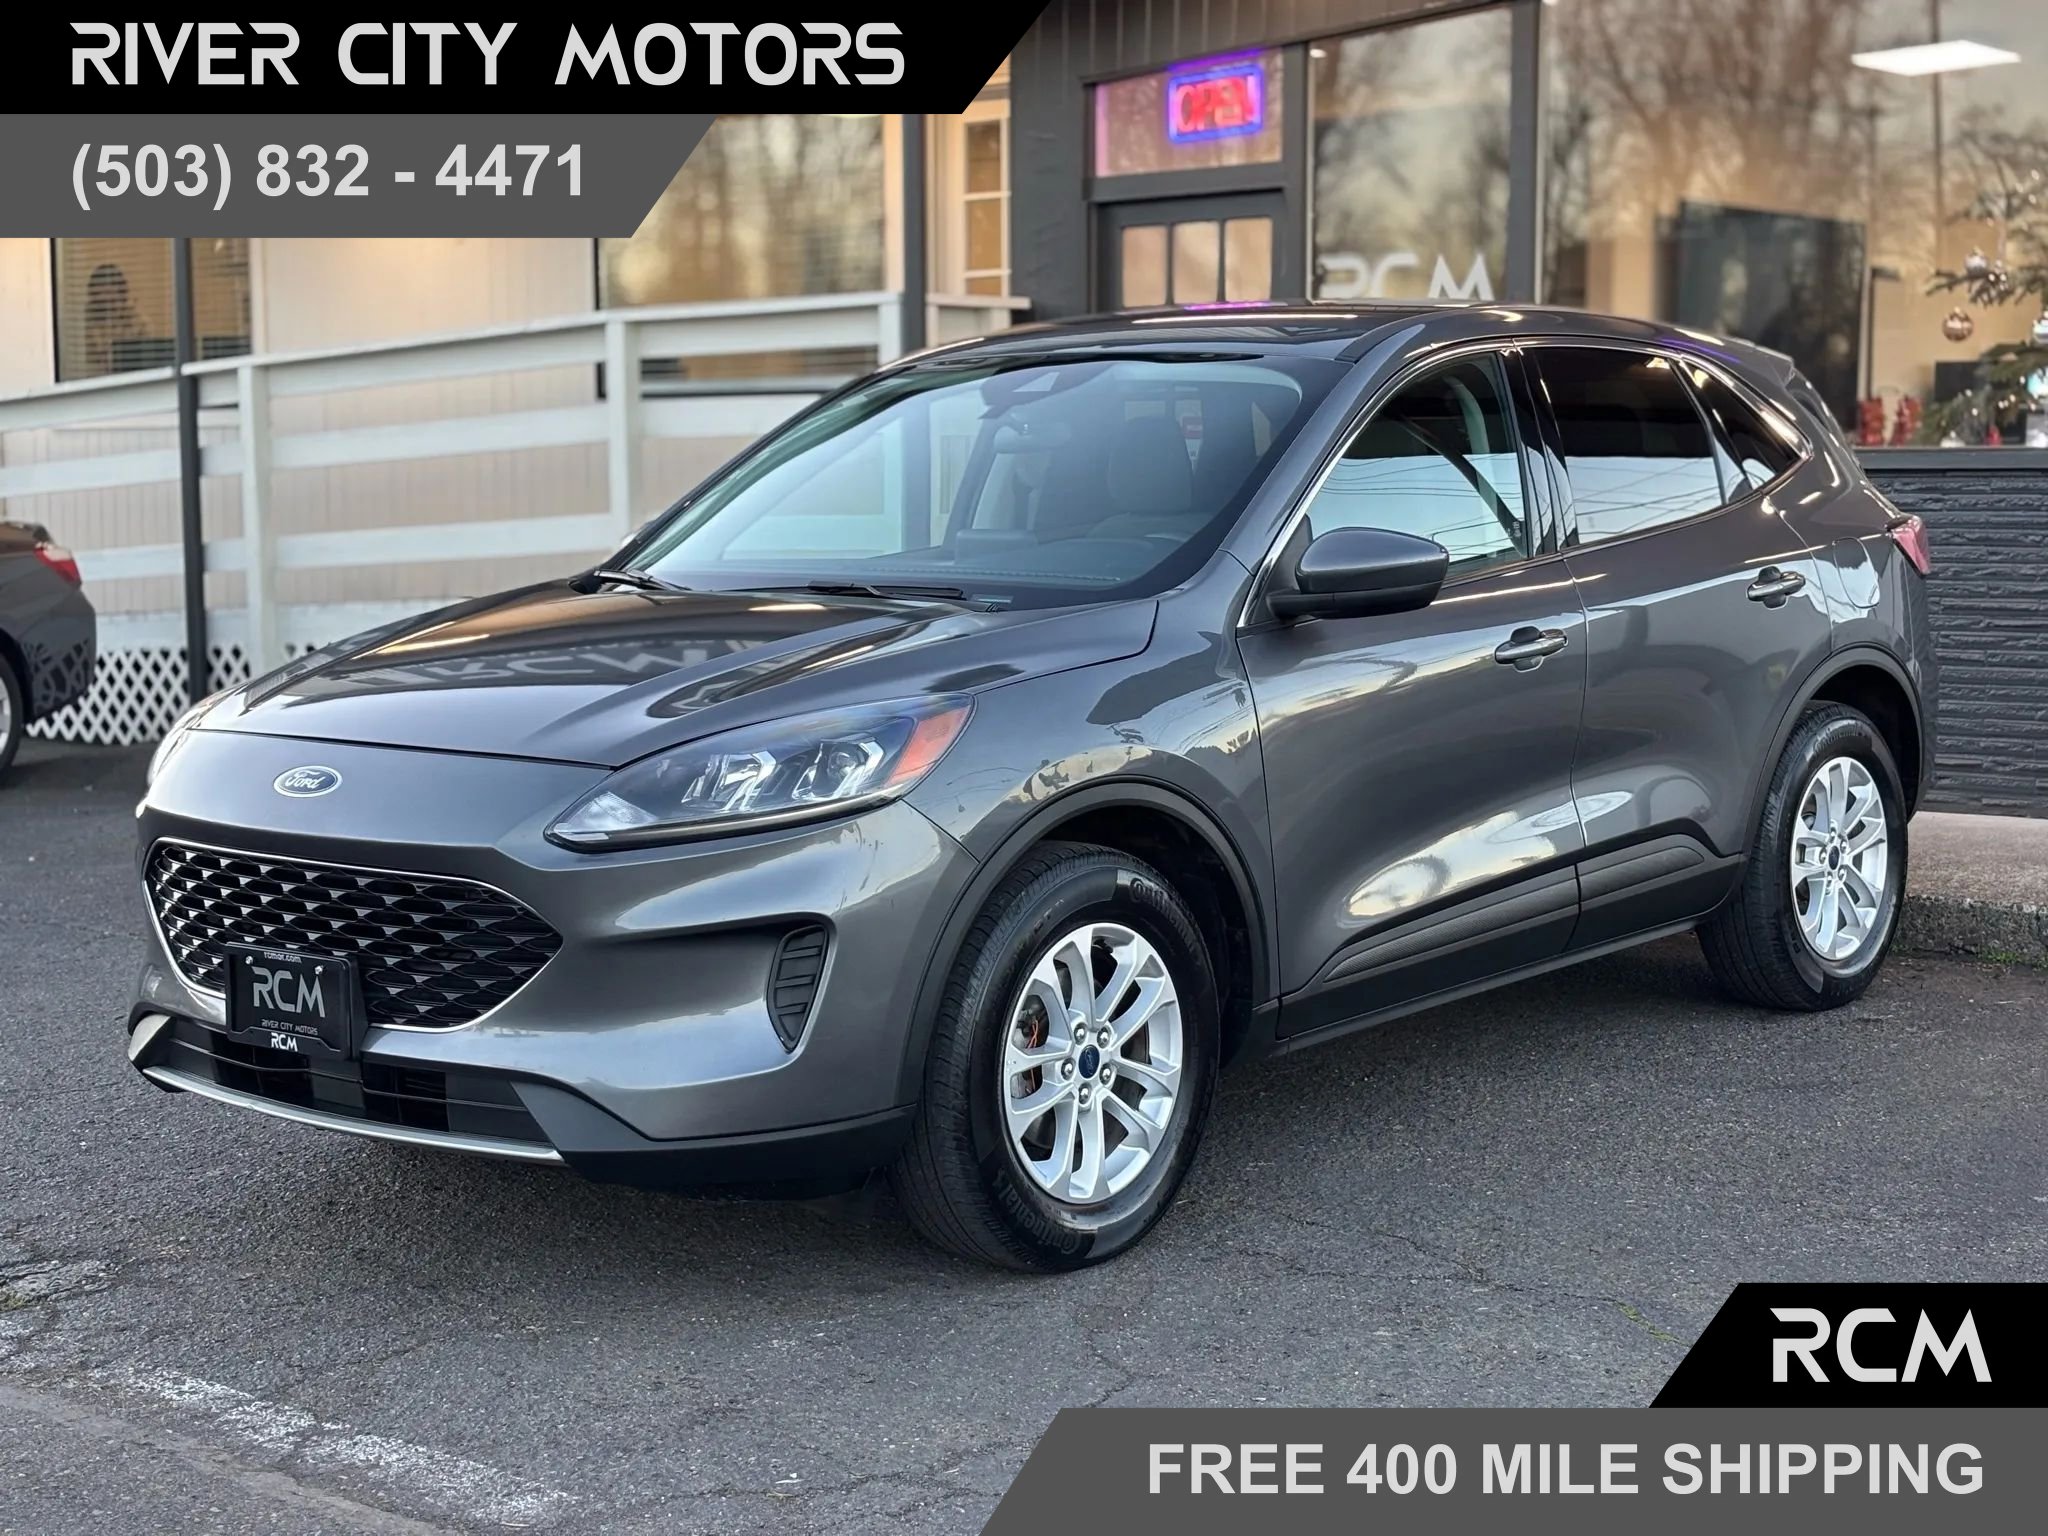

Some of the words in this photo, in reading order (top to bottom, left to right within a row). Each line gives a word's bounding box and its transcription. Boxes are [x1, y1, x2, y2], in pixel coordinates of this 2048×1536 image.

[285, 769, 326, 789] Ford
[251, 965, 326, 1019] RCM
[261, 1018, 279, 1029] RIVER
[280, 1021, 294, 1032] CITY
[294, 1024, 319, 1037] MOTORS
[270, 1031, 299, 1053] RCM
